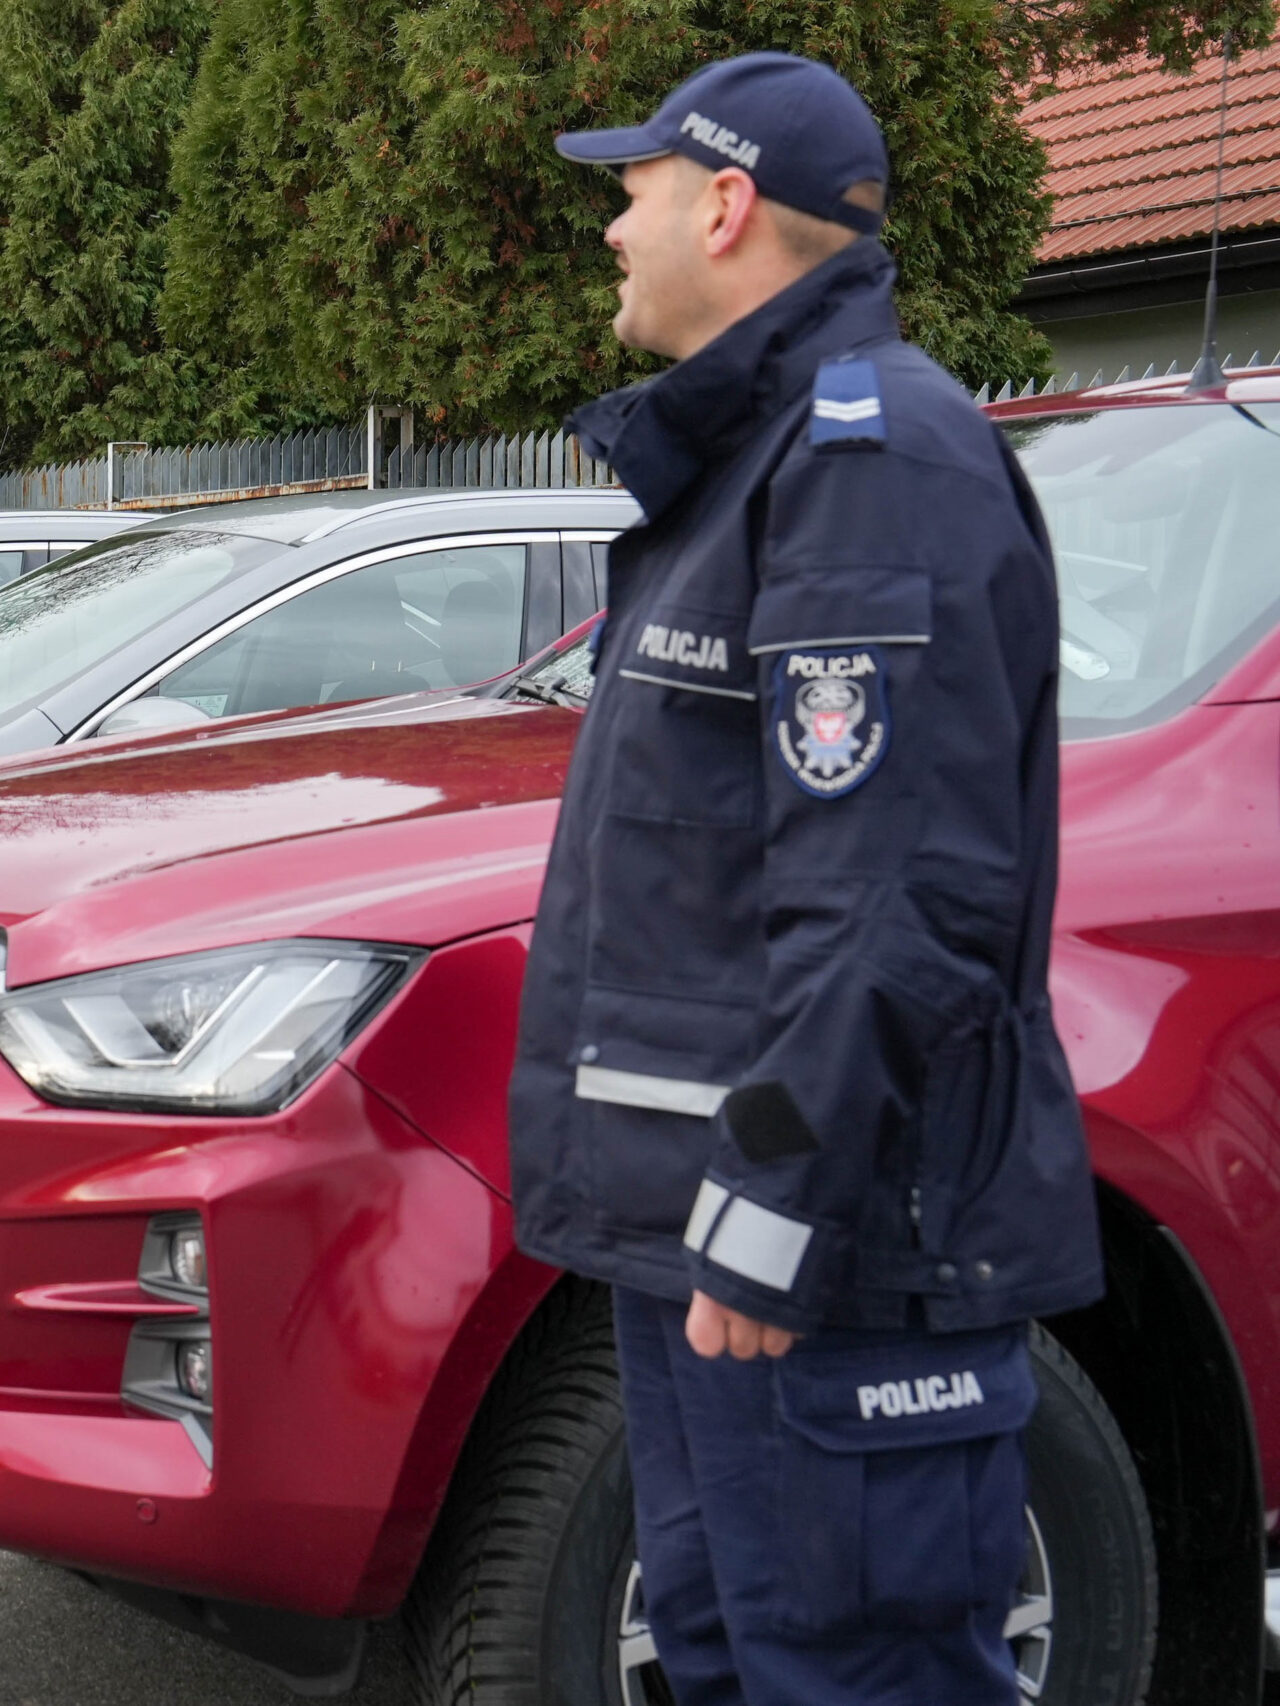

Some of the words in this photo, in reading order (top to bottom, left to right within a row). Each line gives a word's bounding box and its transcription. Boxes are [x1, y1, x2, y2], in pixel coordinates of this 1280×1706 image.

[678, 111, 762, 170] POLICJA
[637, 624, 729, 673] POLICJA
[786, 652, 877, 679] POLICJA
[856, 1369, 985, 1421] POLICJA
